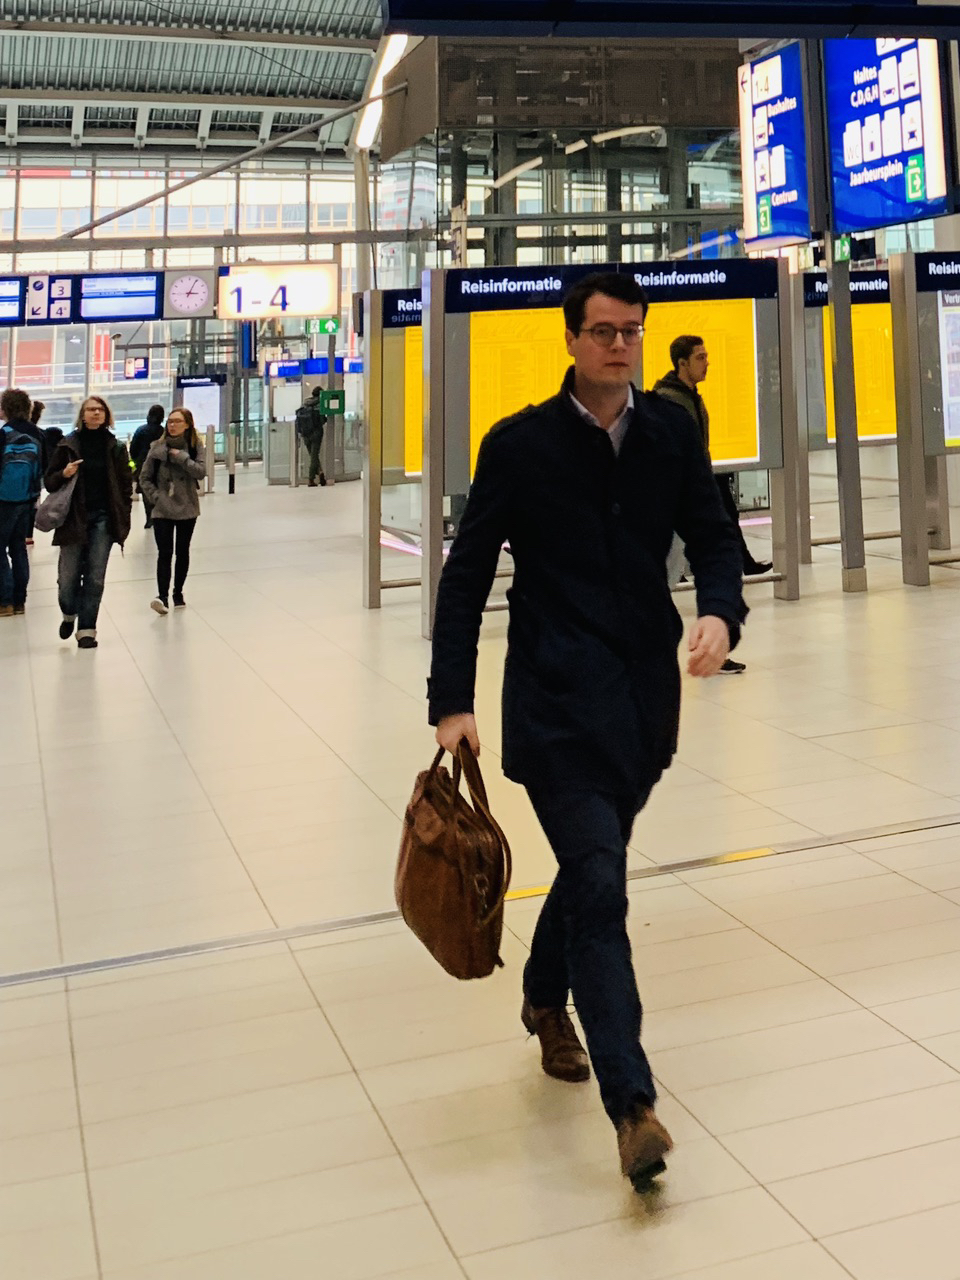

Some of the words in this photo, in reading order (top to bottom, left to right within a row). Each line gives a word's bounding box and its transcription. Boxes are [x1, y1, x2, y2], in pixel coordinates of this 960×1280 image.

[854, 66, 877, 85] Haltes
[850, 159, 903, 188] Jaarbeursplein
[461, 277, 562, 294] Reisinformatie
[634, 269, 726, 286] Reisinformatie
[57, 286, 65, 296] 3
